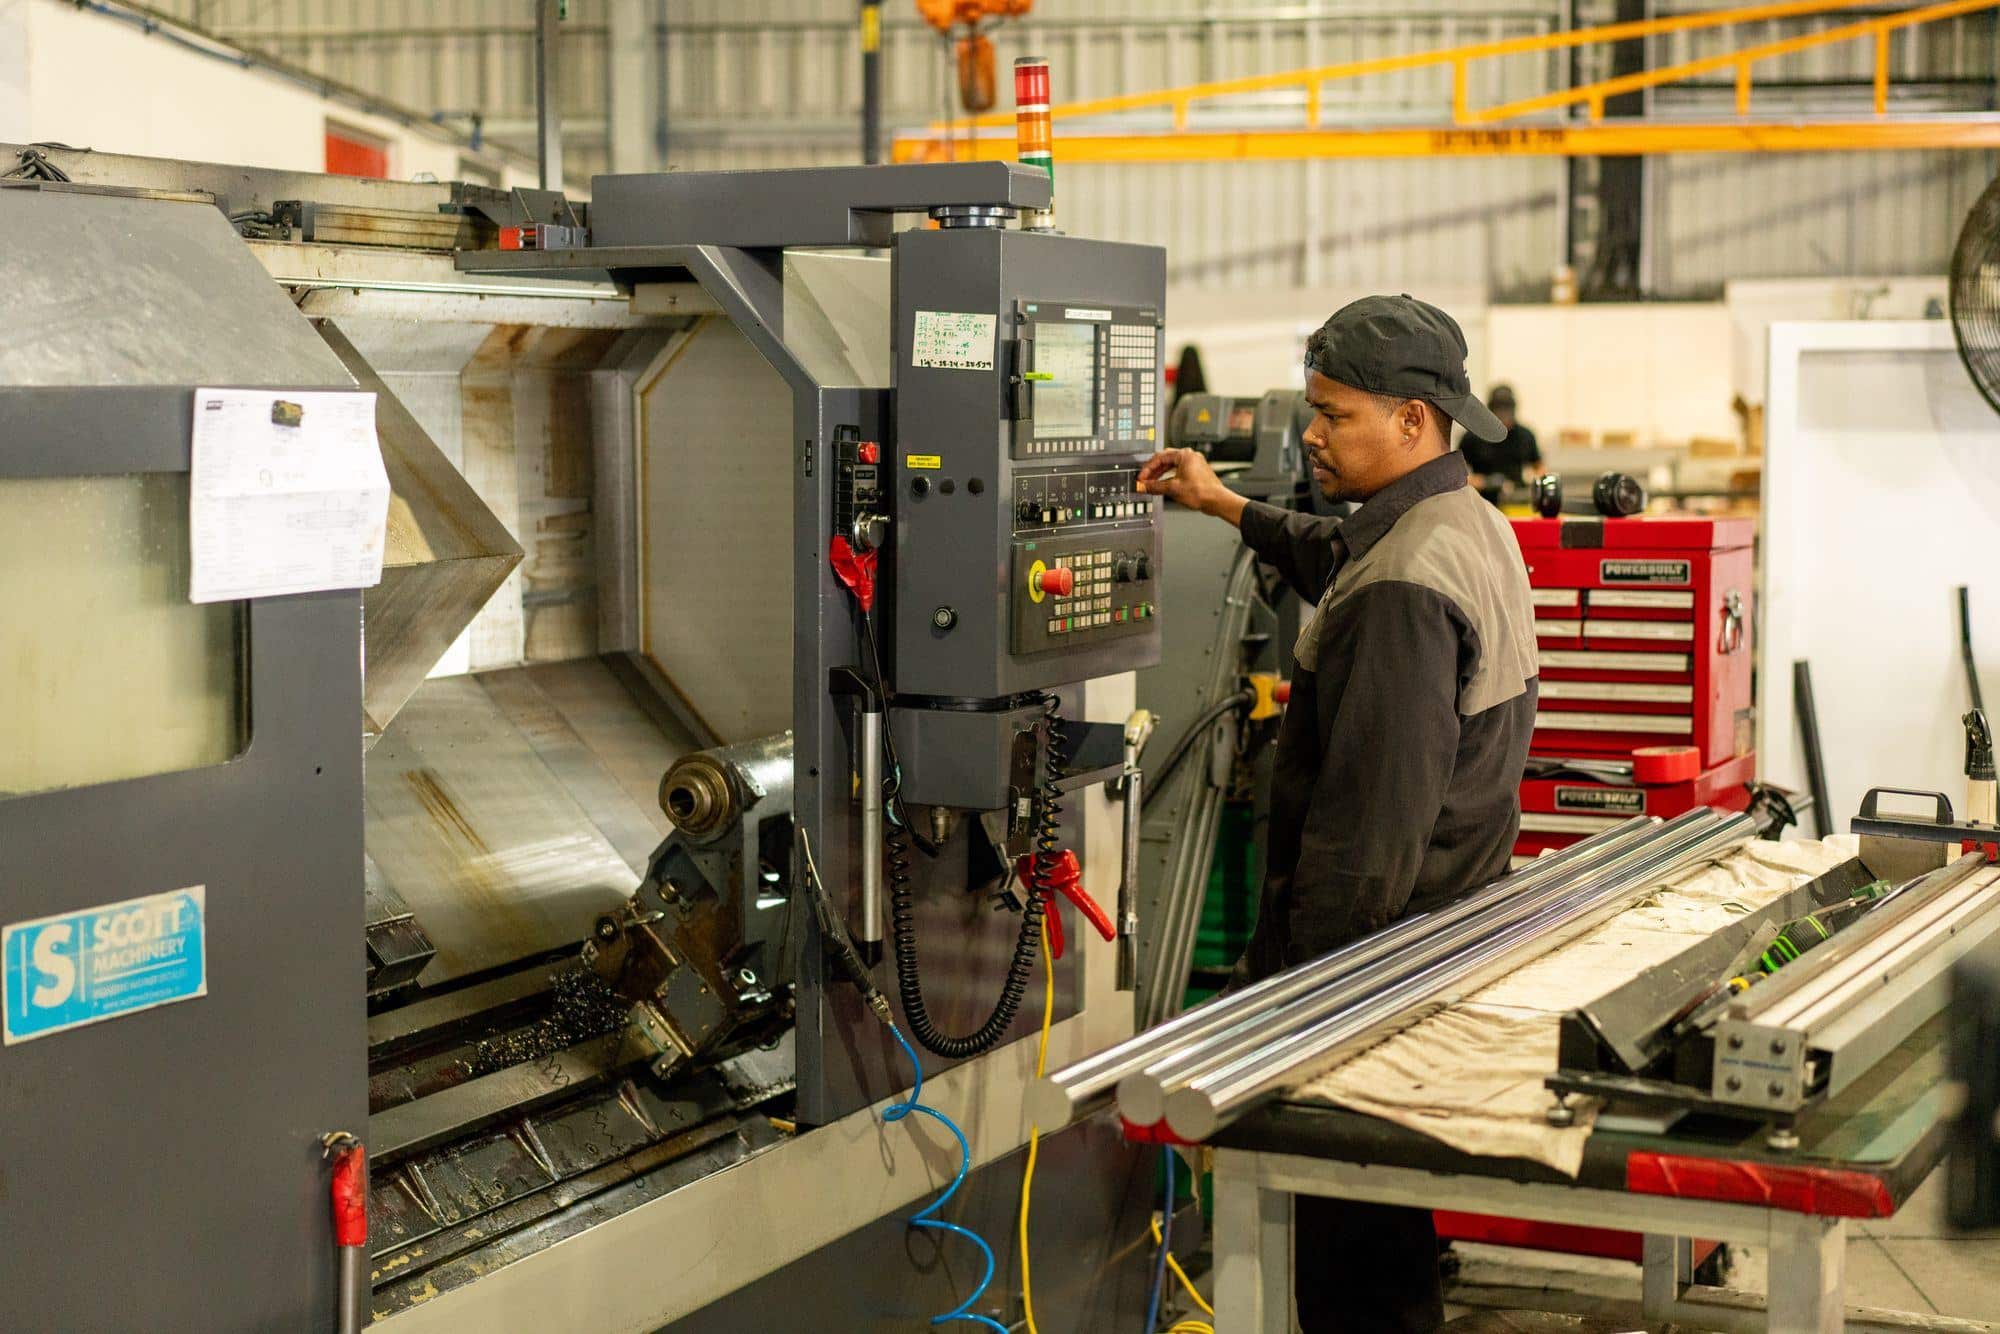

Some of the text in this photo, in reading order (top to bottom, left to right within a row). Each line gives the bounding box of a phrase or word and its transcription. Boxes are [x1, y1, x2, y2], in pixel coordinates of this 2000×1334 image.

[1605, 564, 1684, 576] POWERBUILT
[92, 900, 186, 953] SCOTT
[31, 923, 76, 1008] S
[92, 936, 186, 976] MACHINERY
